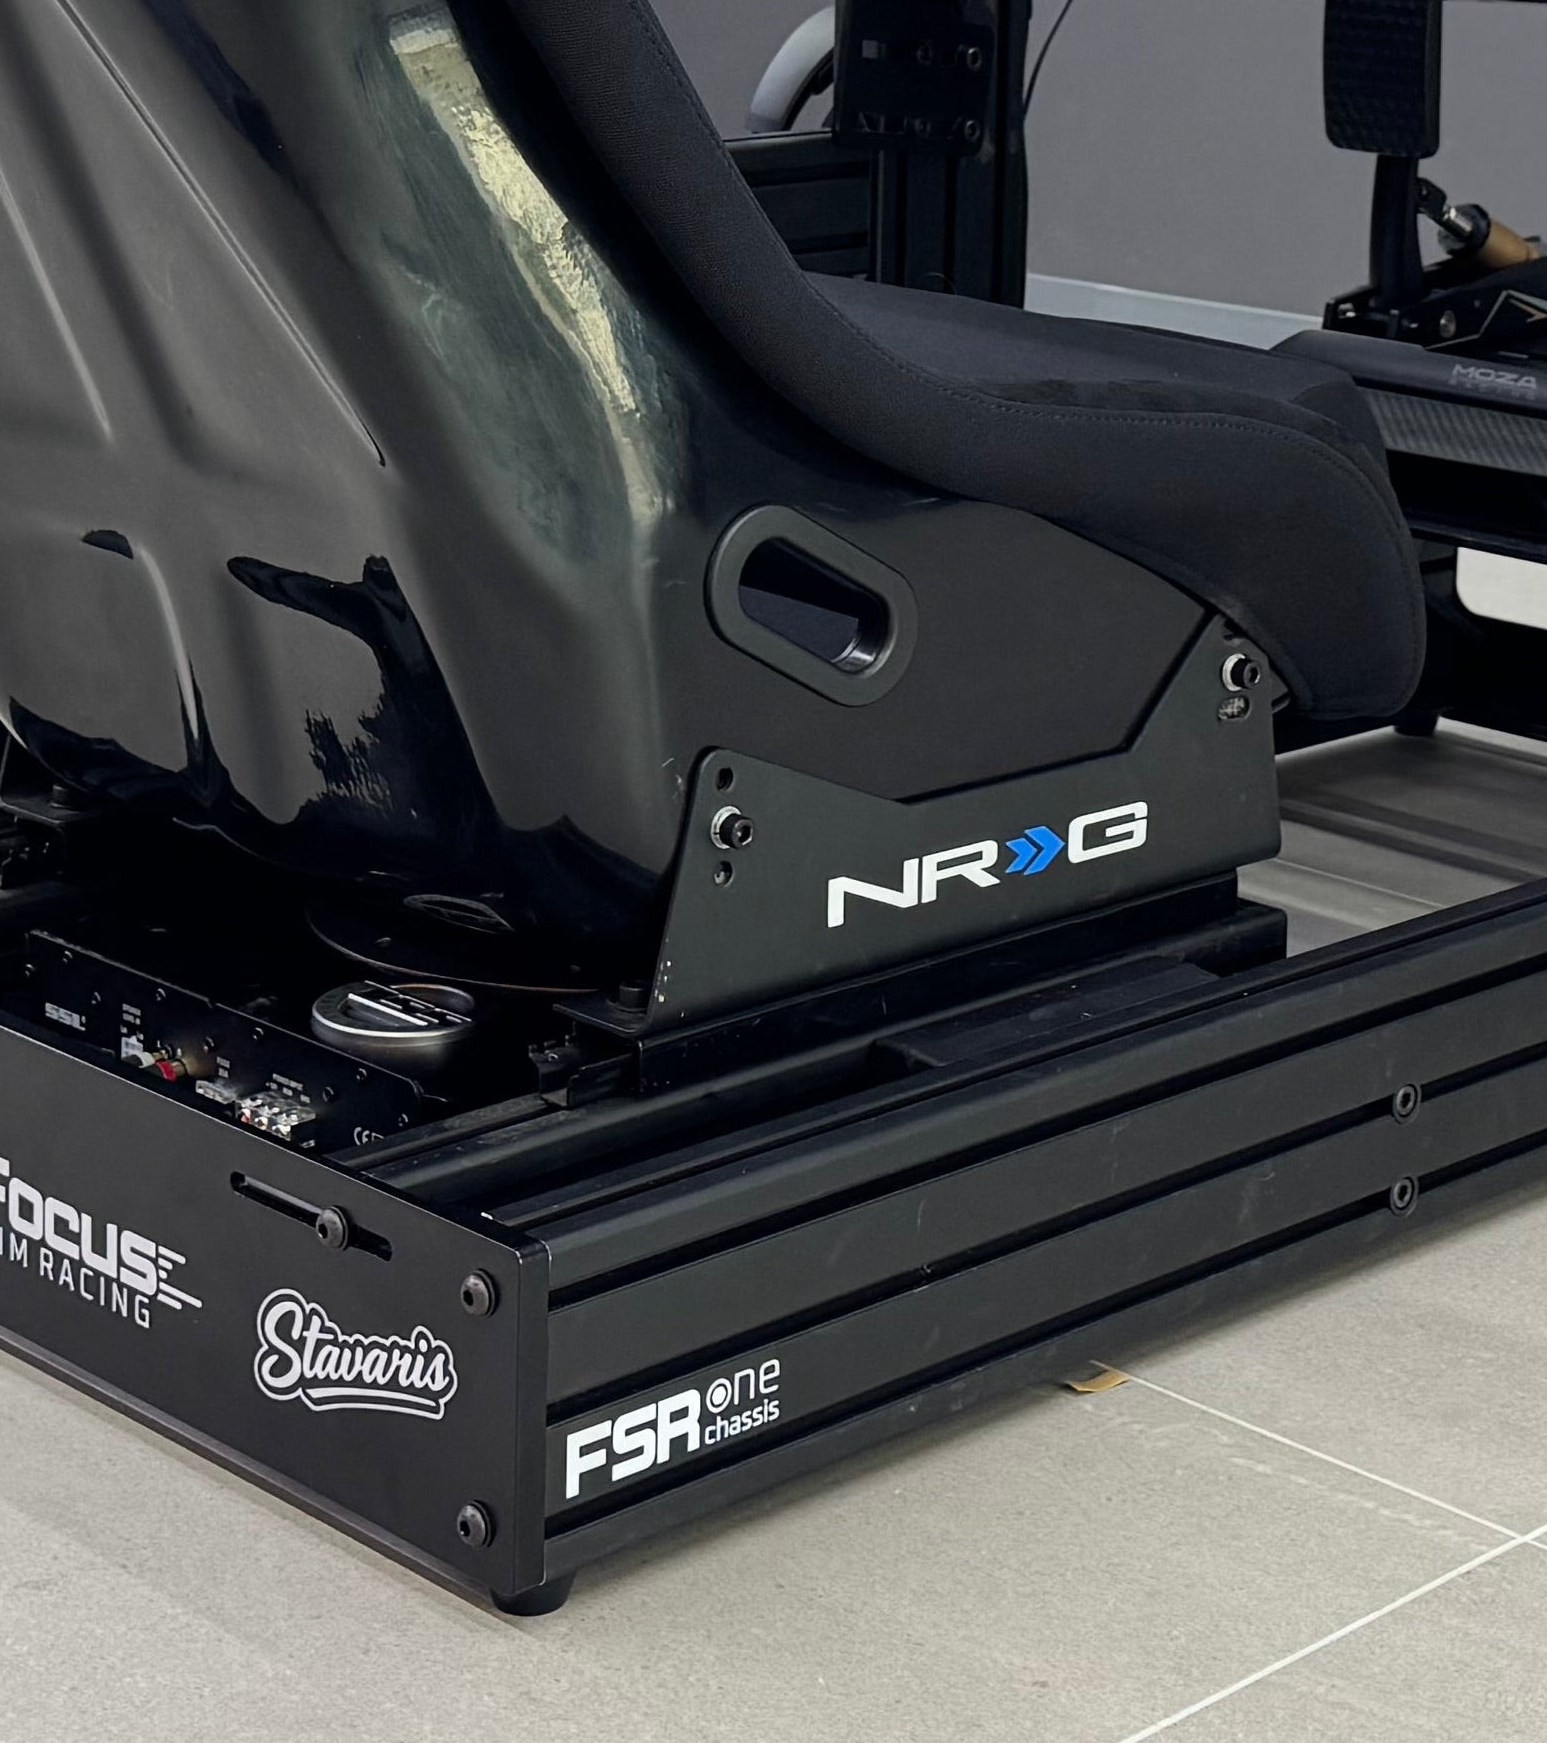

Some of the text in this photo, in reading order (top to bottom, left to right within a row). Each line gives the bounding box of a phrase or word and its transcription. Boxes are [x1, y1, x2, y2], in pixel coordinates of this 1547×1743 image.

[1451, 363, 1537, 389] MOZA
[827, 800, 1149, 929] NRG
[39, 1246, 151, 1329] RACING
[260, 1300, 451, 1392] Stavaris
[565, 1388, 702, 1500] FSR
[704, 1398, 781, 1445] chassis
